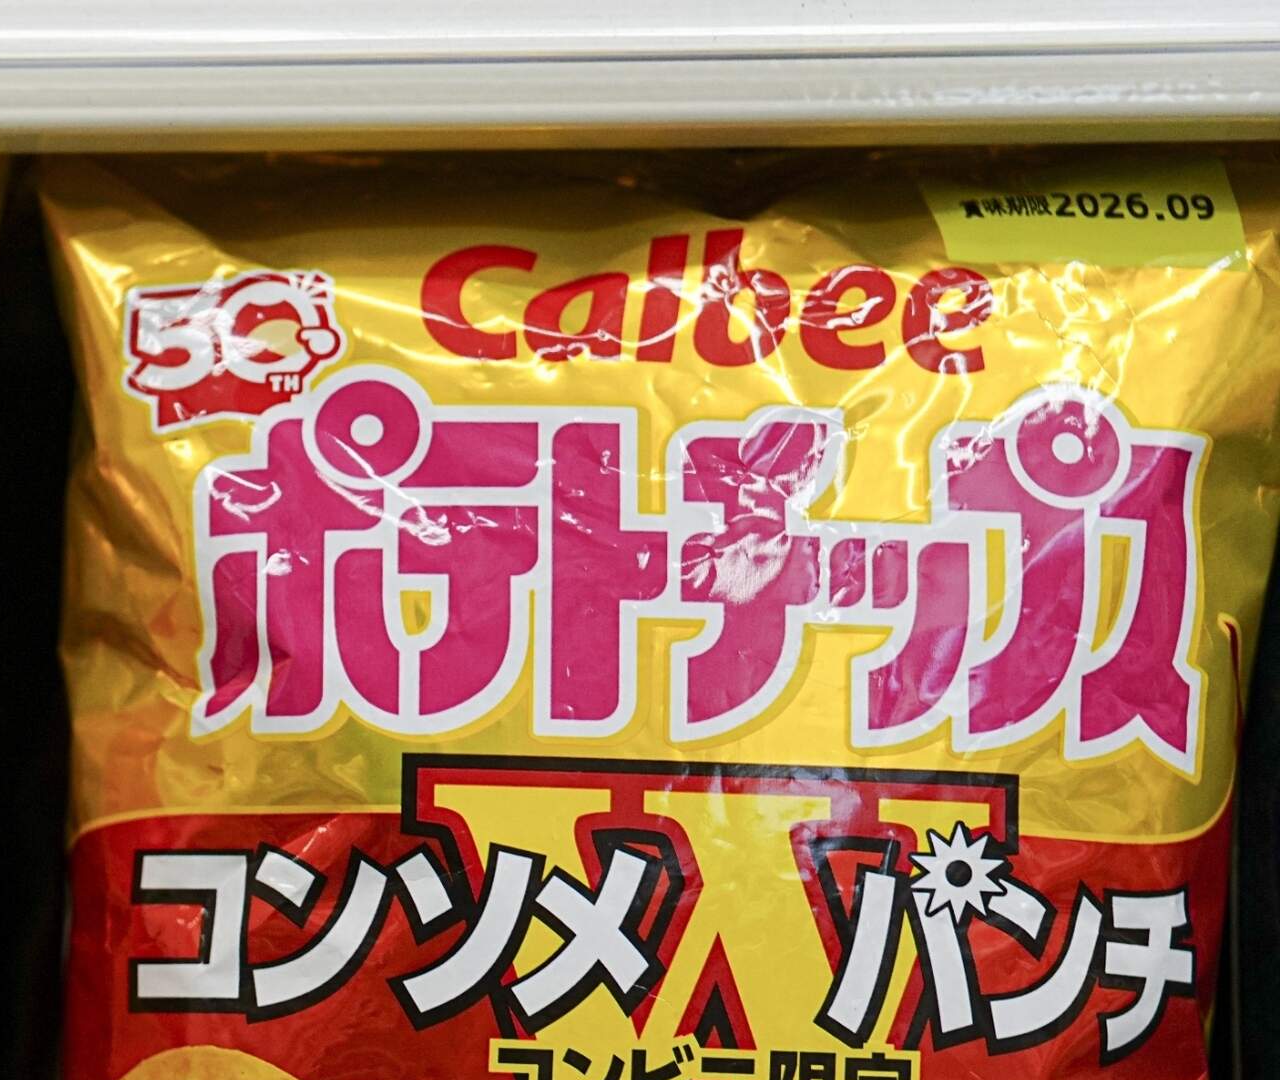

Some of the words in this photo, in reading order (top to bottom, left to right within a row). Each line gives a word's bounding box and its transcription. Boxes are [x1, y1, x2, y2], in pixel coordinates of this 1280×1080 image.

[1051, 192, 1215, 221] 2026.09
[134, 278, 338, 392] 50
[420, 227, 996, 374] Calbee
[268, 374, 301, 393] TH
[190, 364, 1208, 777] ポテトチップス
[132, 843, 657, 1032] コンソメ
[823, 822, 1197, 1060] パンチ
